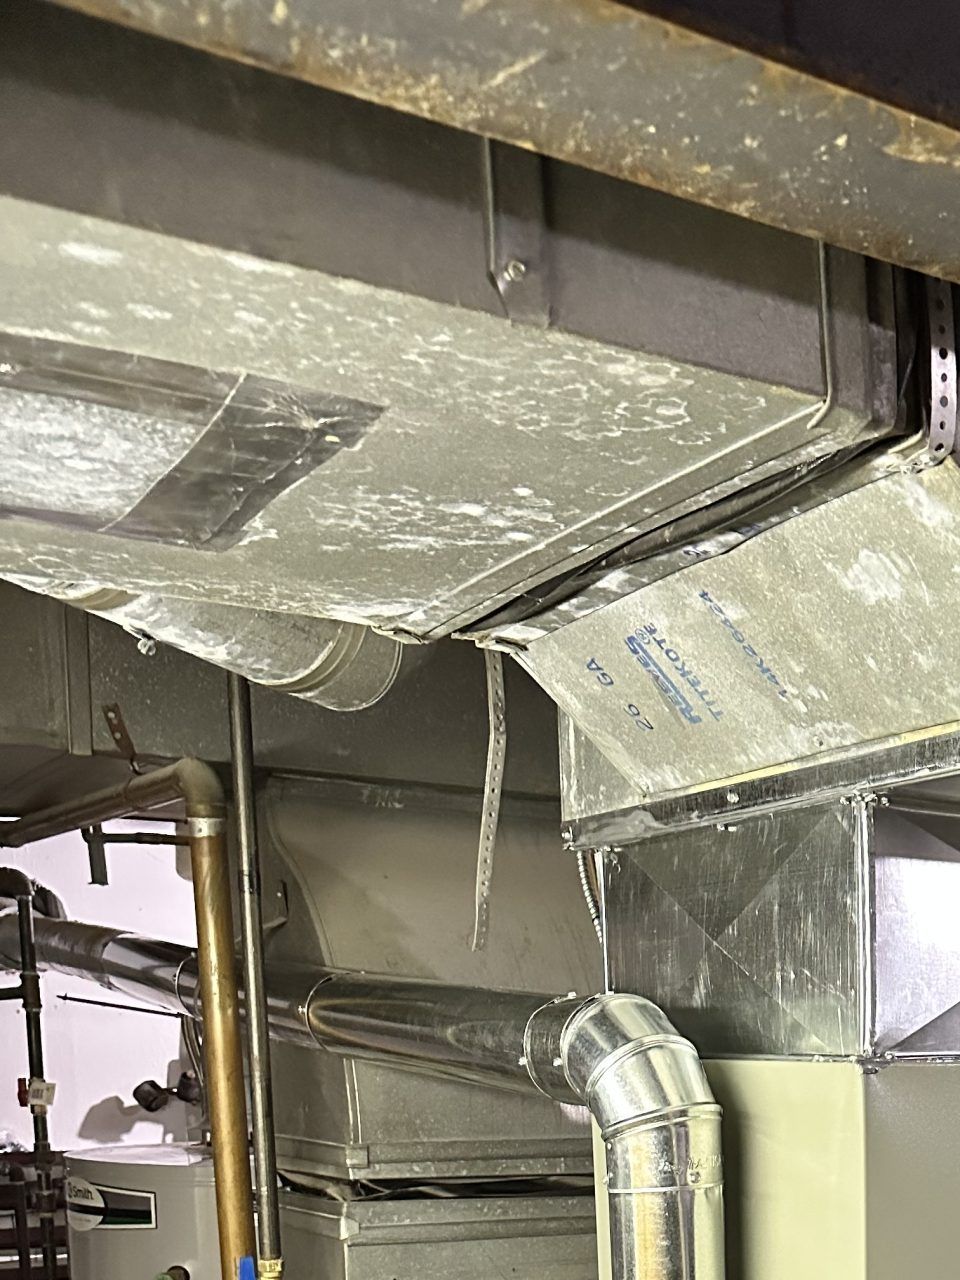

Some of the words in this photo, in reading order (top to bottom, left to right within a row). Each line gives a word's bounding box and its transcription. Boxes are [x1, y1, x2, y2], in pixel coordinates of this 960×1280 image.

[586, 657, 614, 687] GA
[643, 622, 724, 722] TITEKOTE
[623, 703, 655, 731] 26
